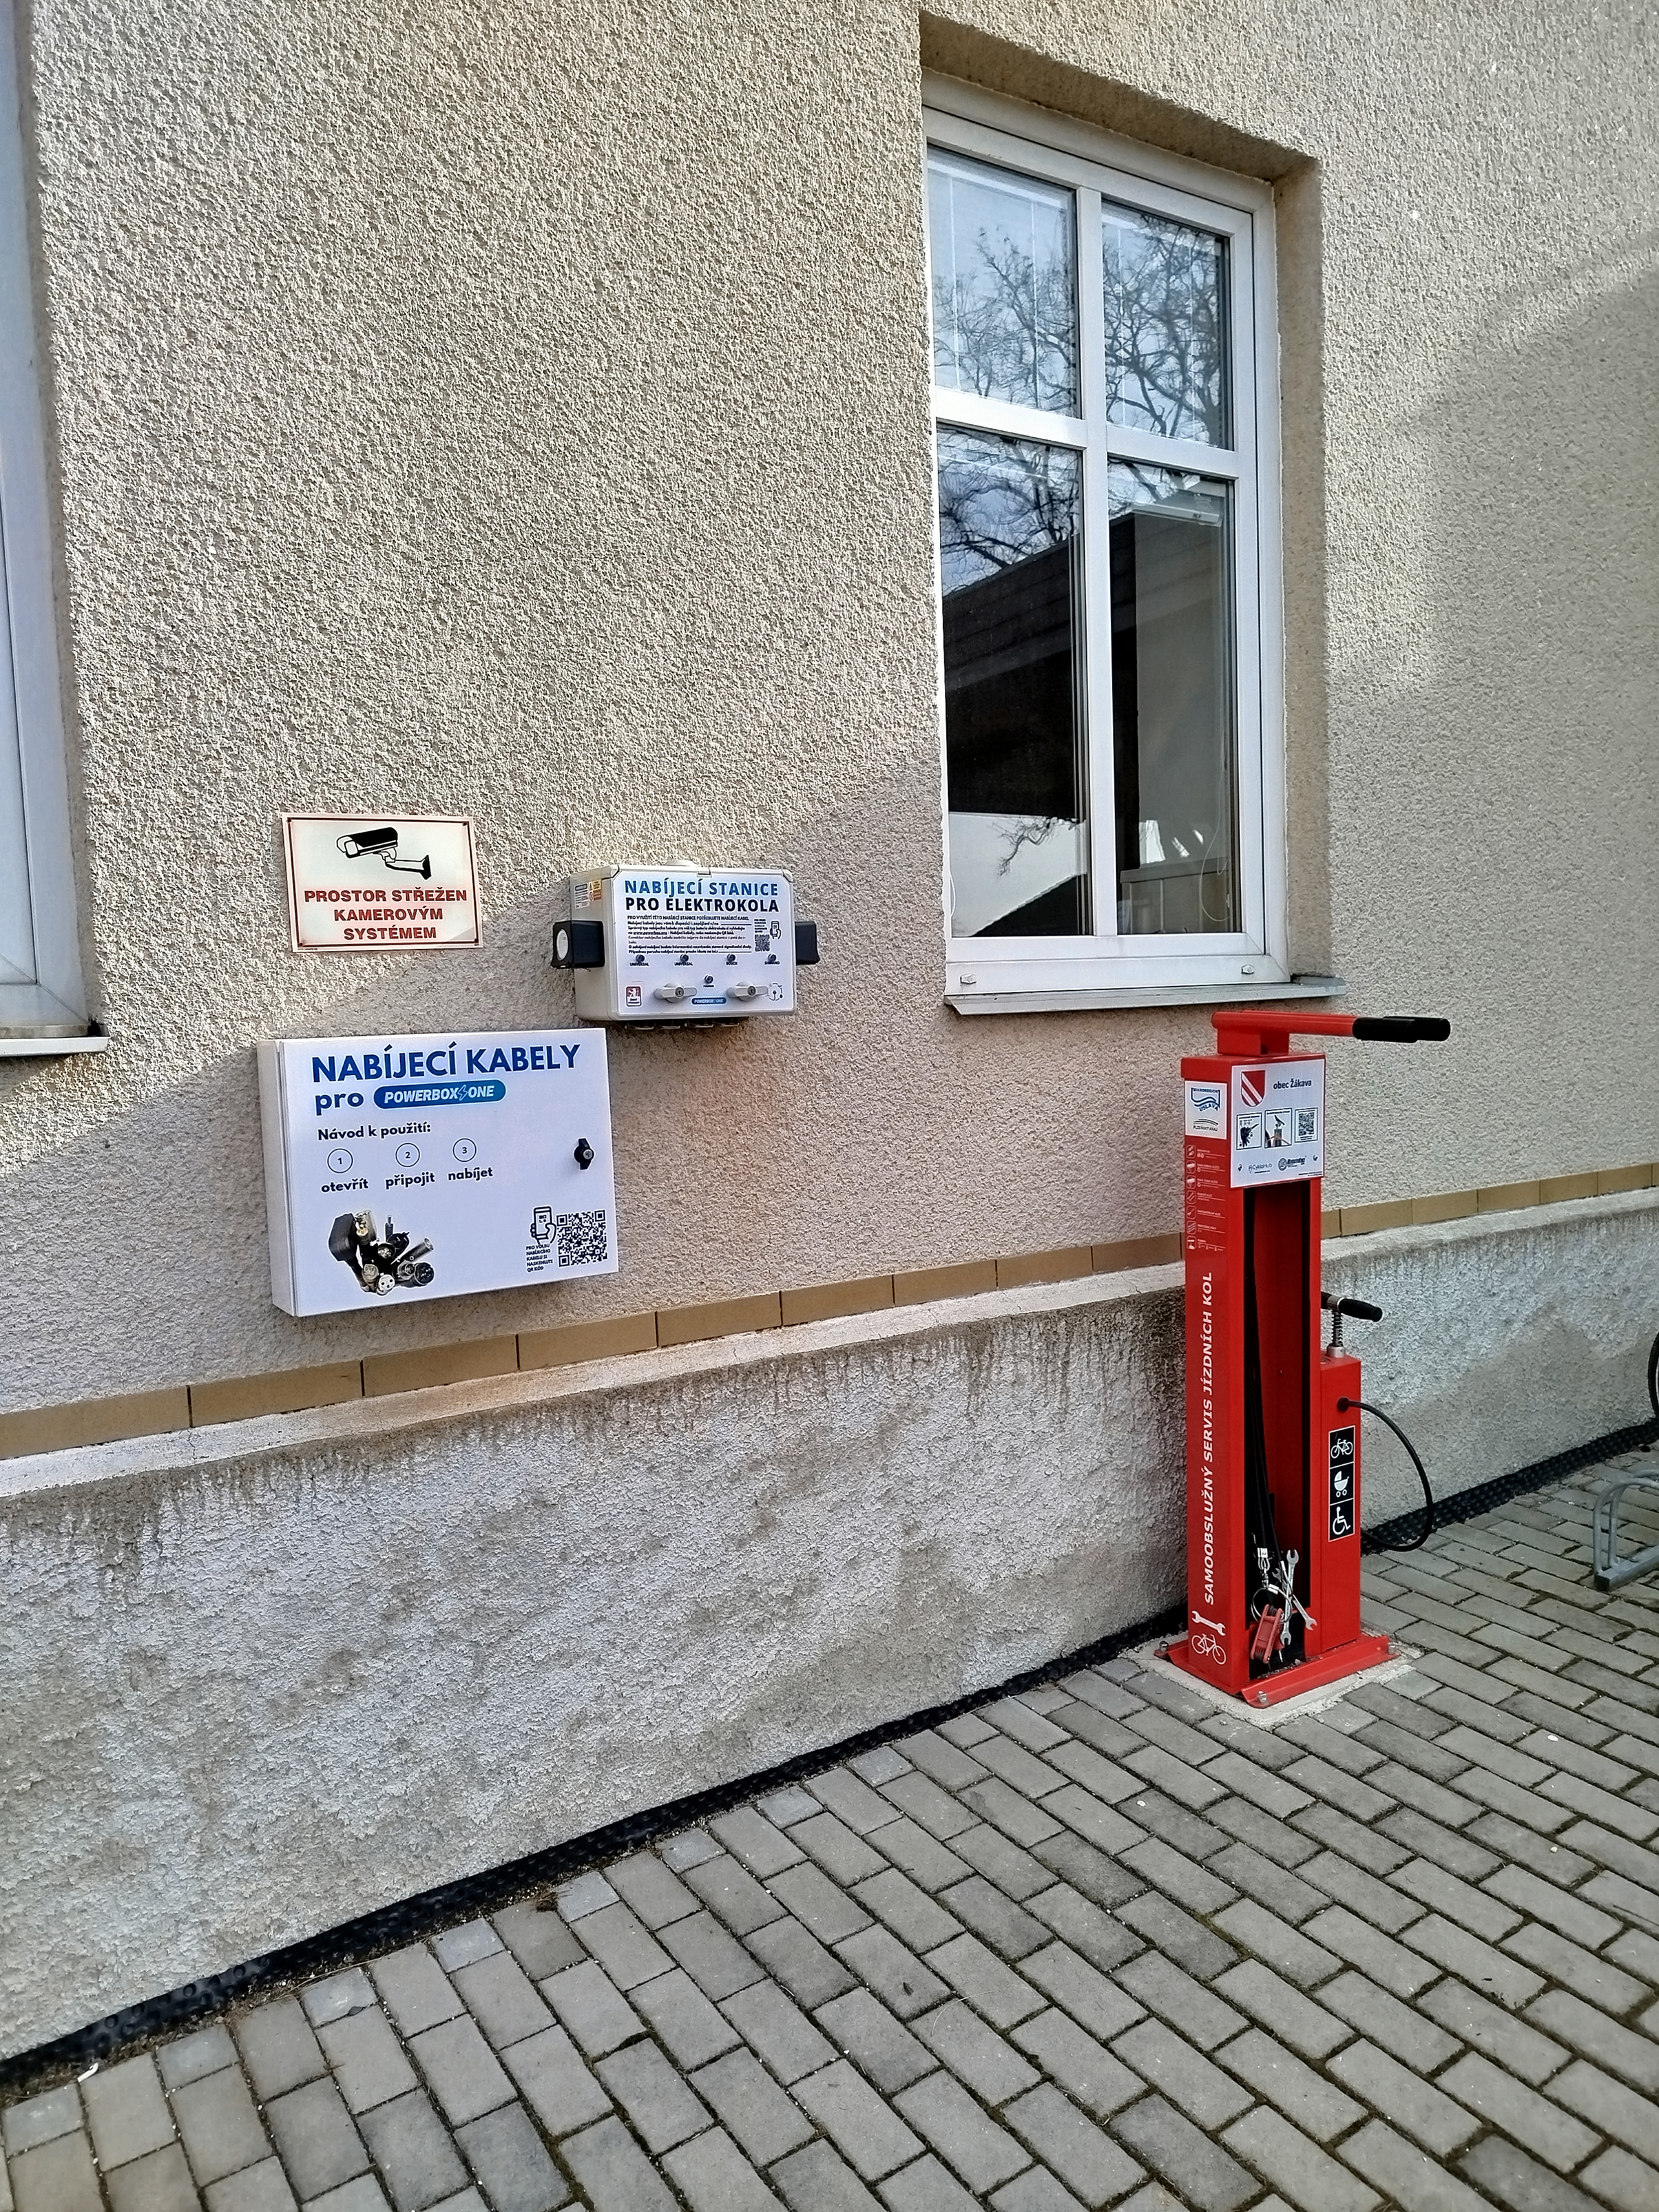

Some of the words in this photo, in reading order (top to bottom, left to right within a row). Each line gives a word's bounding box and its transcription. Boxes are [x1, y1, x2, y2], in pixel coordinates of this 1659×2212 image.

[305, 890, 386, 902] PROSTOR
[392, 887, 467, 901] STŘEŽEN
[625, 878, 703, 898] NABÍJECÍ
[709, 883, 778, 895] STANICE
[335, 906, 442, 921] KAMEROVÝM
[626, 898, 659, 910] PRO
[666, 898, 779, 912] ELEKTROKOLA
[344, 925, 436, 940] SYSTÉMEM
[312, 1041, 457, 1082] NABÍJECÍ
[466, 1044, 581, 1074] KABELY
[1273, 1081, 1289, 1089] obec
[1290, 1078, 1312, 1088] Žákava
[315, 1092, 364, 1115] pro
[384, 1088, 458, 1104] POWERBOX
[468, 1085, 495, 1098] ONE
[317, 1125, 364, 1140] Návod
[368, 1125, 377, 1137] k
[380, 1121, 431, 1139] použití:
[321, 1178, 369, 1193] otevřít
[385, 1171, 435, 1190] připojit
[447, 1167, 494, 1181] nabíjet
[1202, 1272, 1212, 1306] KOL
[1200, 1311, 1213, 1396] JÍZDNÍCH
[1203, 1399, 1213, 1463] SERVIS
[1201, 1465, 1214, 1605] SAMOOBSLUŽNÝ
